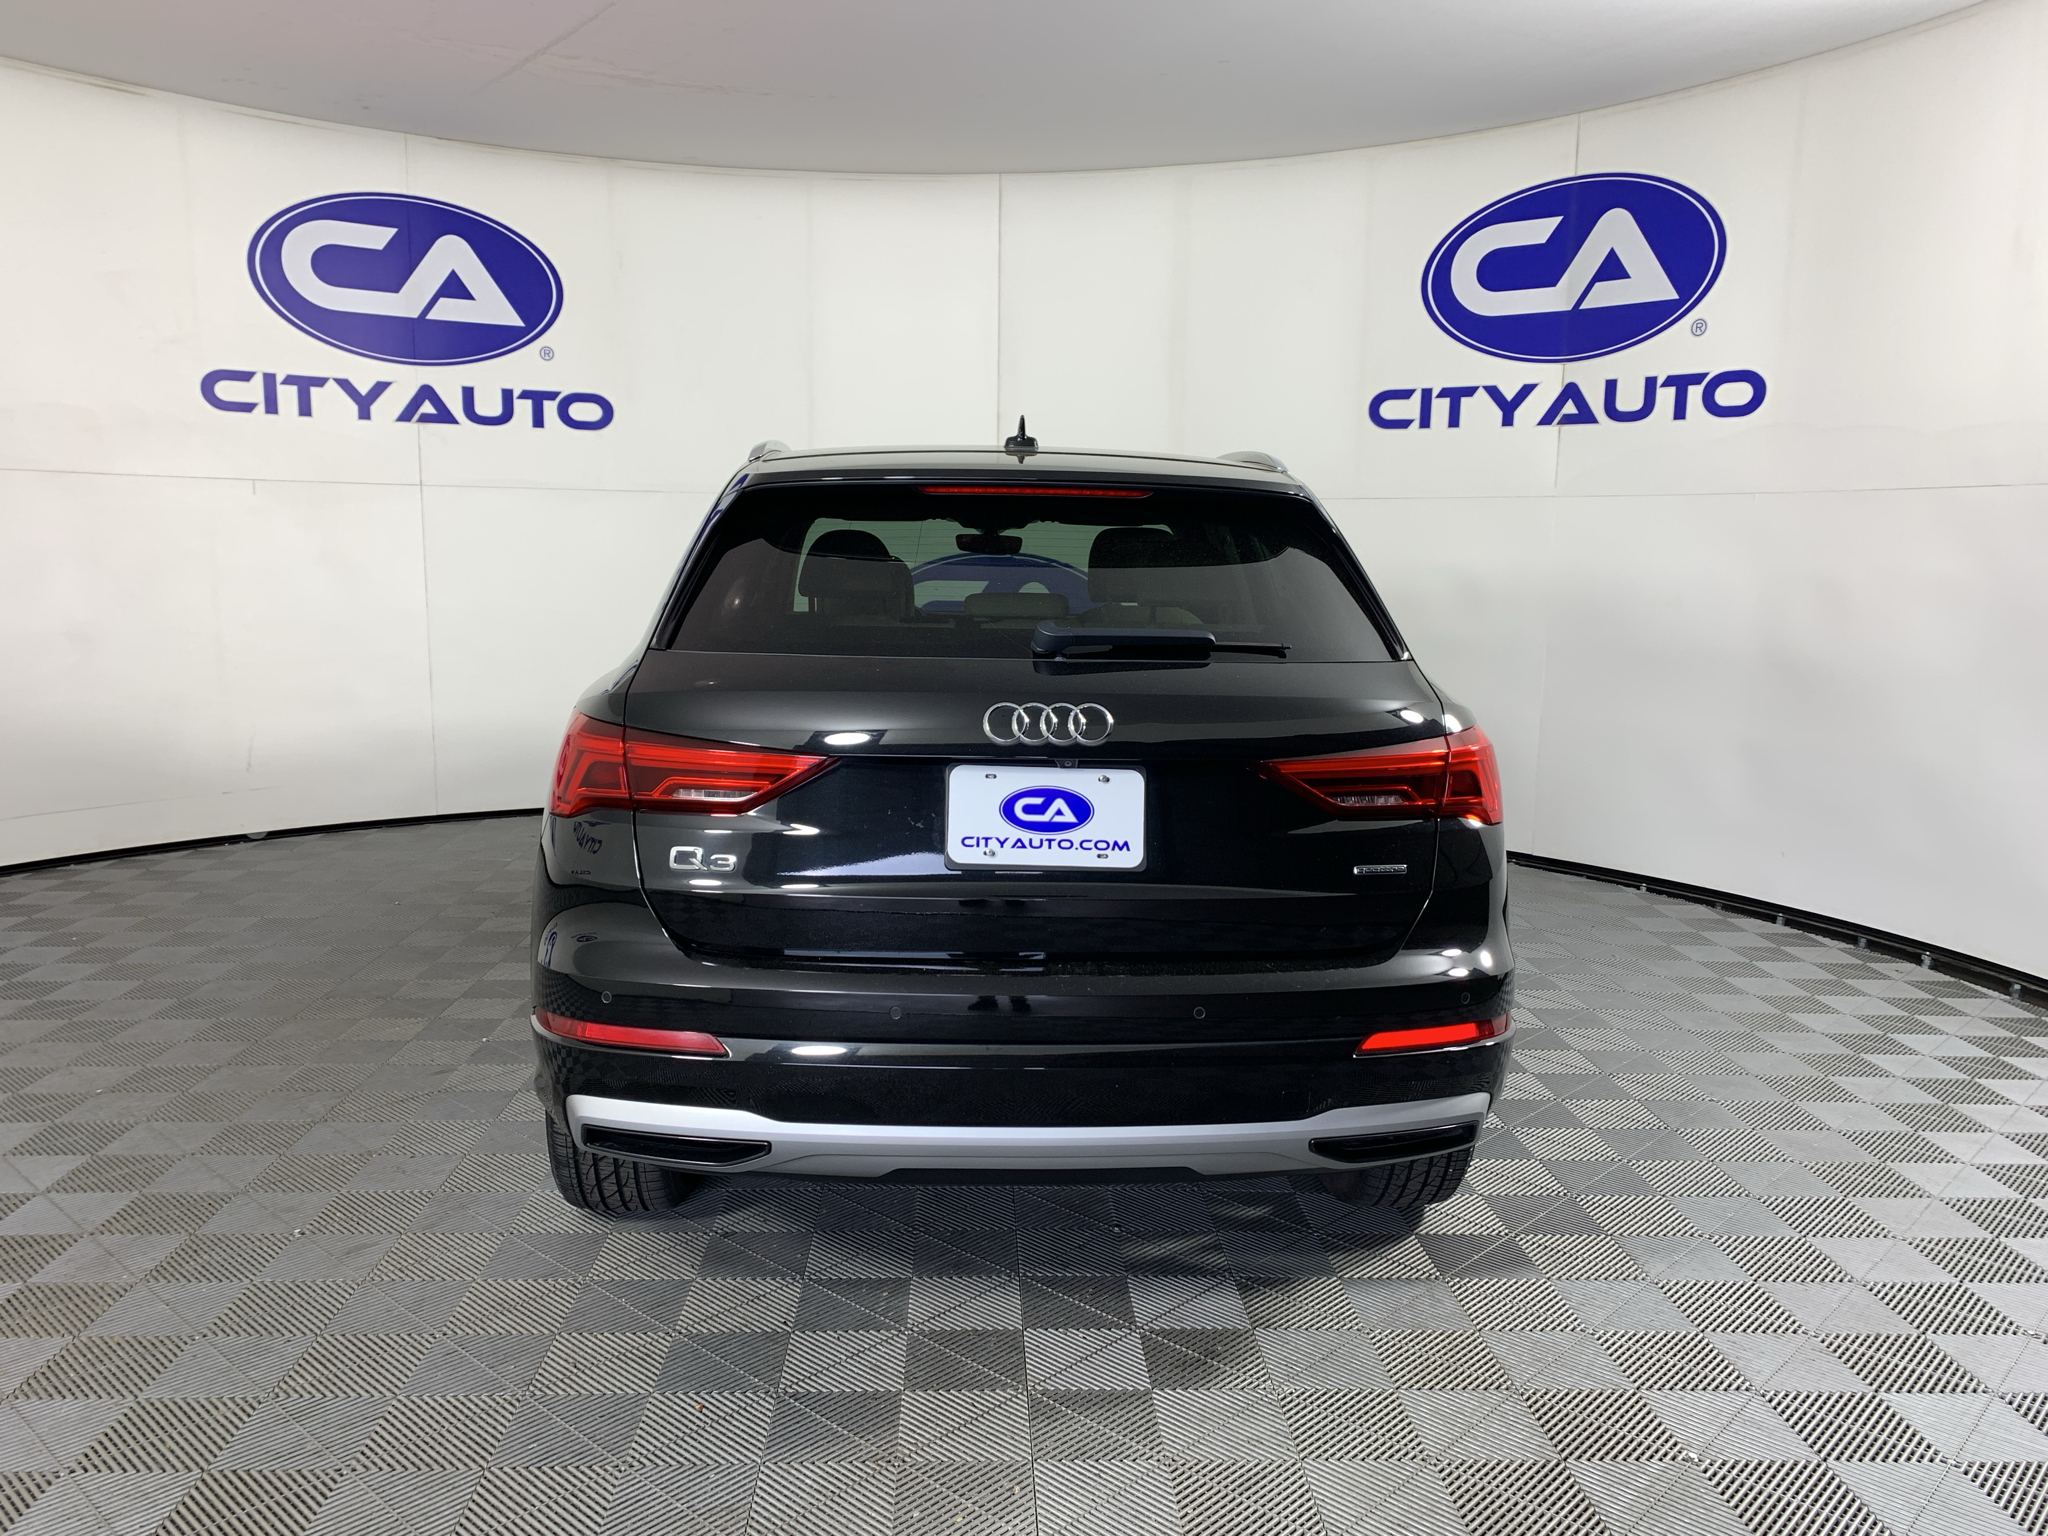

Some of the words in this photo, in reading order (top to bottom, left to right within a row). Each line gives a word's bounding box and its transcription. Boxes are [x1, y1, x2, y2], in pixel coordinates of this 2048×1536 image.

[281, 219, 526, 327] CA
[1450, 207, 1680, 317] CA
[200, 369, 394, 421] CITY
[395, 384, 614, 430] AUTO
[1368, 383, 1540, 430] CITY
[1536, 369, 1767, 426] AUTO
[1014, 797, 1079, 823] CA
[669, 846, 738, 871] Q3
[960, 836, 1131, 852] CITYAUTO.COM
